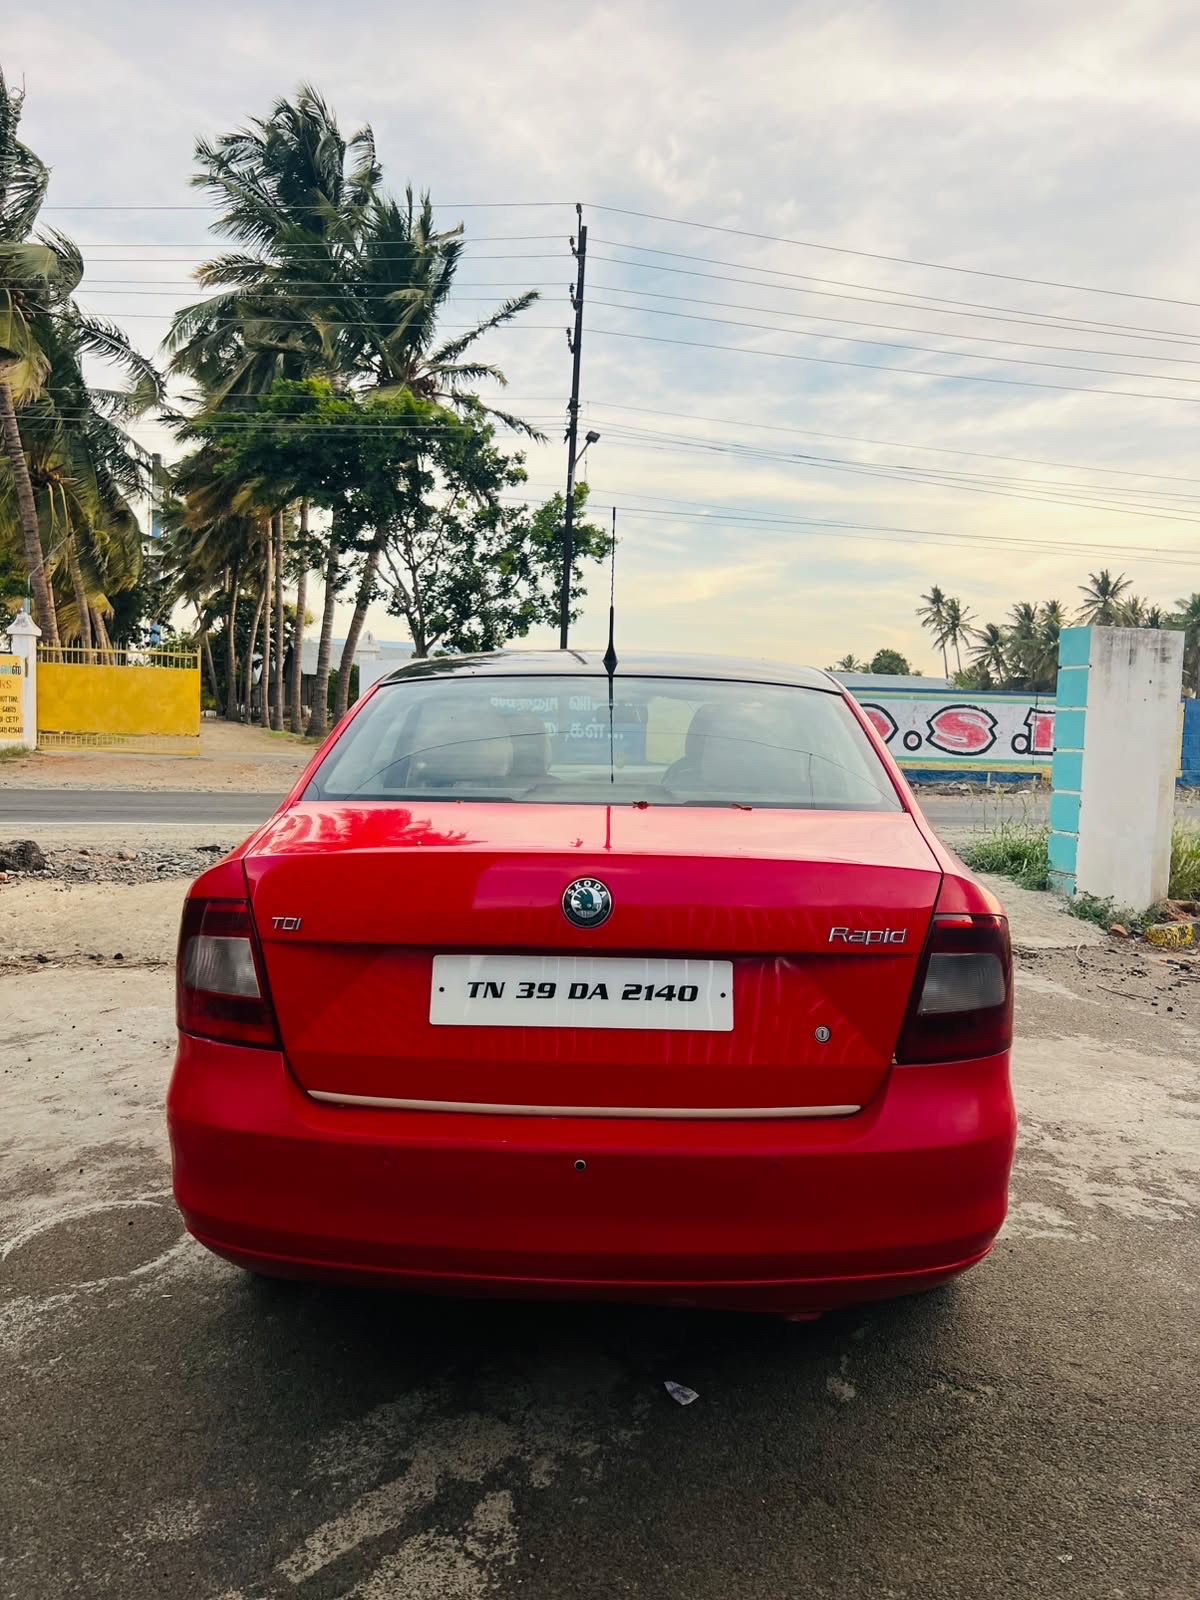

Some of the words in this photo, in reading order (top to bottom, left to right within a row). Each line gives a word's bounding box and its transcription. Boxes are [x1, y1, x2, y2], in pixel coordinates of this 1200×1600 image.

[271, 916, 302, 930] TDI
[828, 926, 907, 945] Rapid
[467, 981, 506, 998] TN
[515, 982, 556, 999] 39
[567, 983, 609, 1000] DA
[621, 984, 699, 1002] 2140
